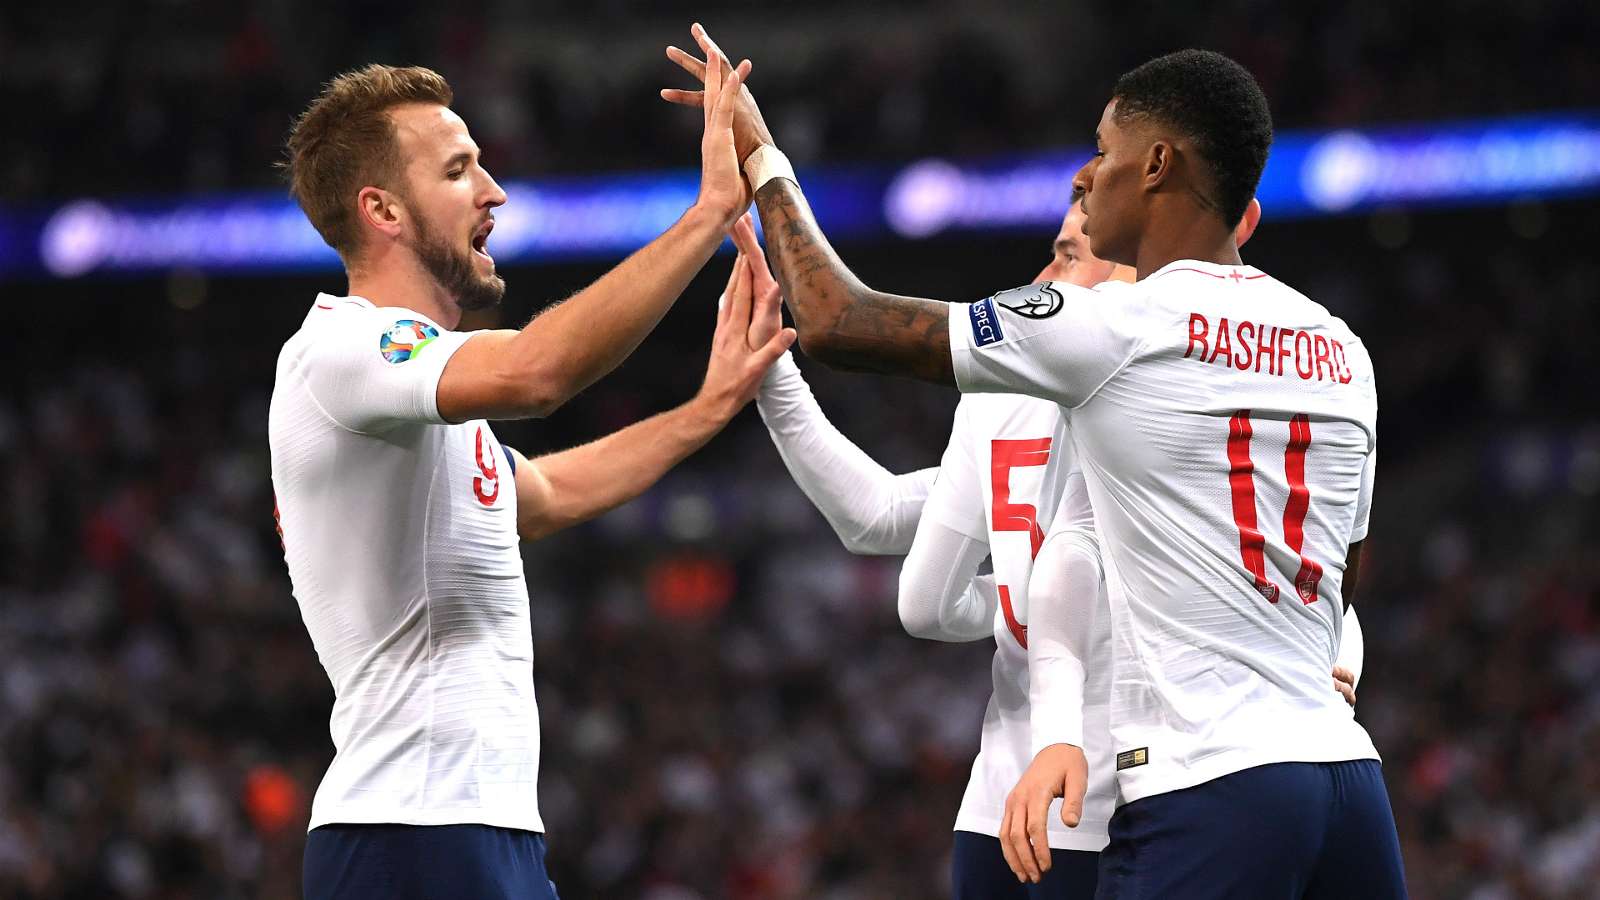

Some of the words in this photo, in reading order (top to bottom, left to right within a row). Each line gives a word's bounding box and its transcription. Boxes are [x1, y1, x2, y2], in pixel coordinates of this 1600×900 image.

[1184, 312, 1352, 385] RASHFORD
[472, 425, 500, 506] 9
[1227, 408, 1324, 606] 11
[990, 437, 1052, 651] 5
